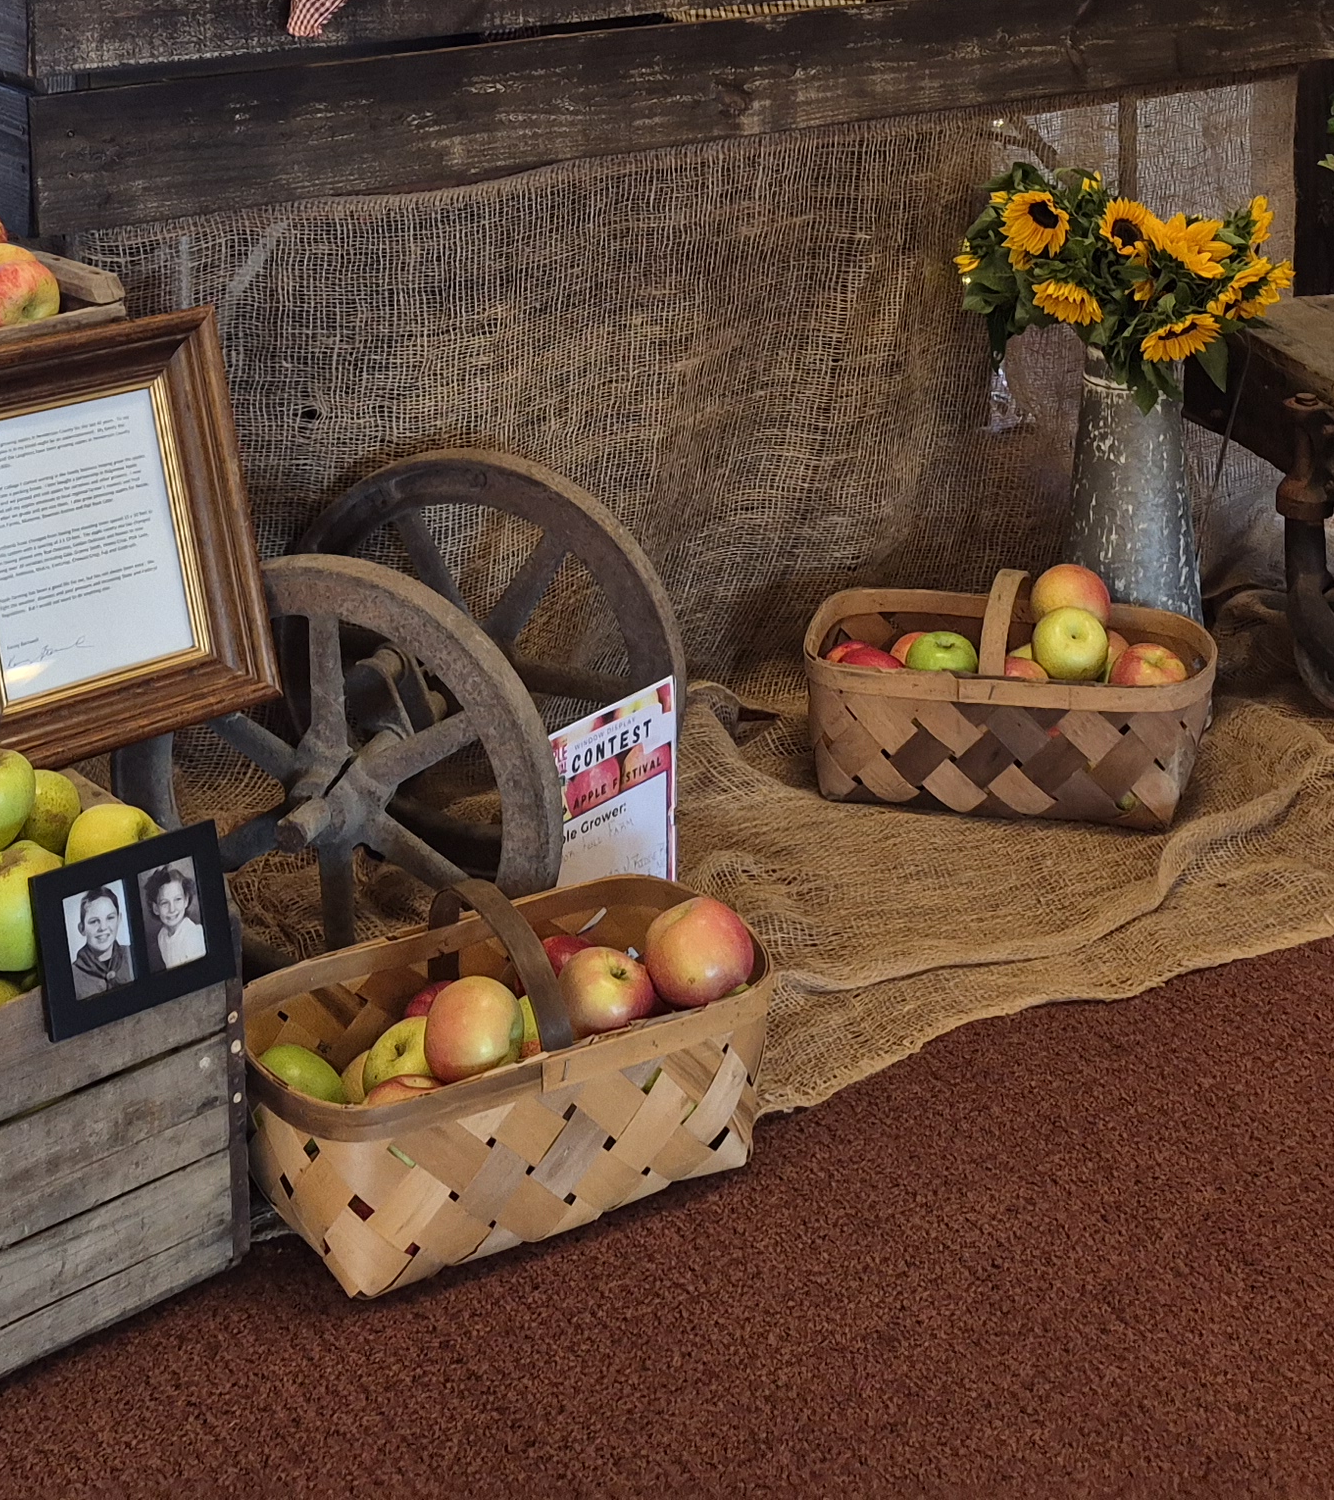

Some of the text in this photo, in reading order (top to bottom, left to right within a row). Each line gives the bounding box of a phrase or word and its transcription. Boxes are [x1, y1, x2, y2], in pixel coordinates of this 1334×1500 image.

[571, 718, 652, 774] CONTEST
[574, 717, 636, 750] WINDOW DISPLAY
[573, 756, 662, 810] APPLE FESTIVAL
[580, 802, 627, 834] Grower:
